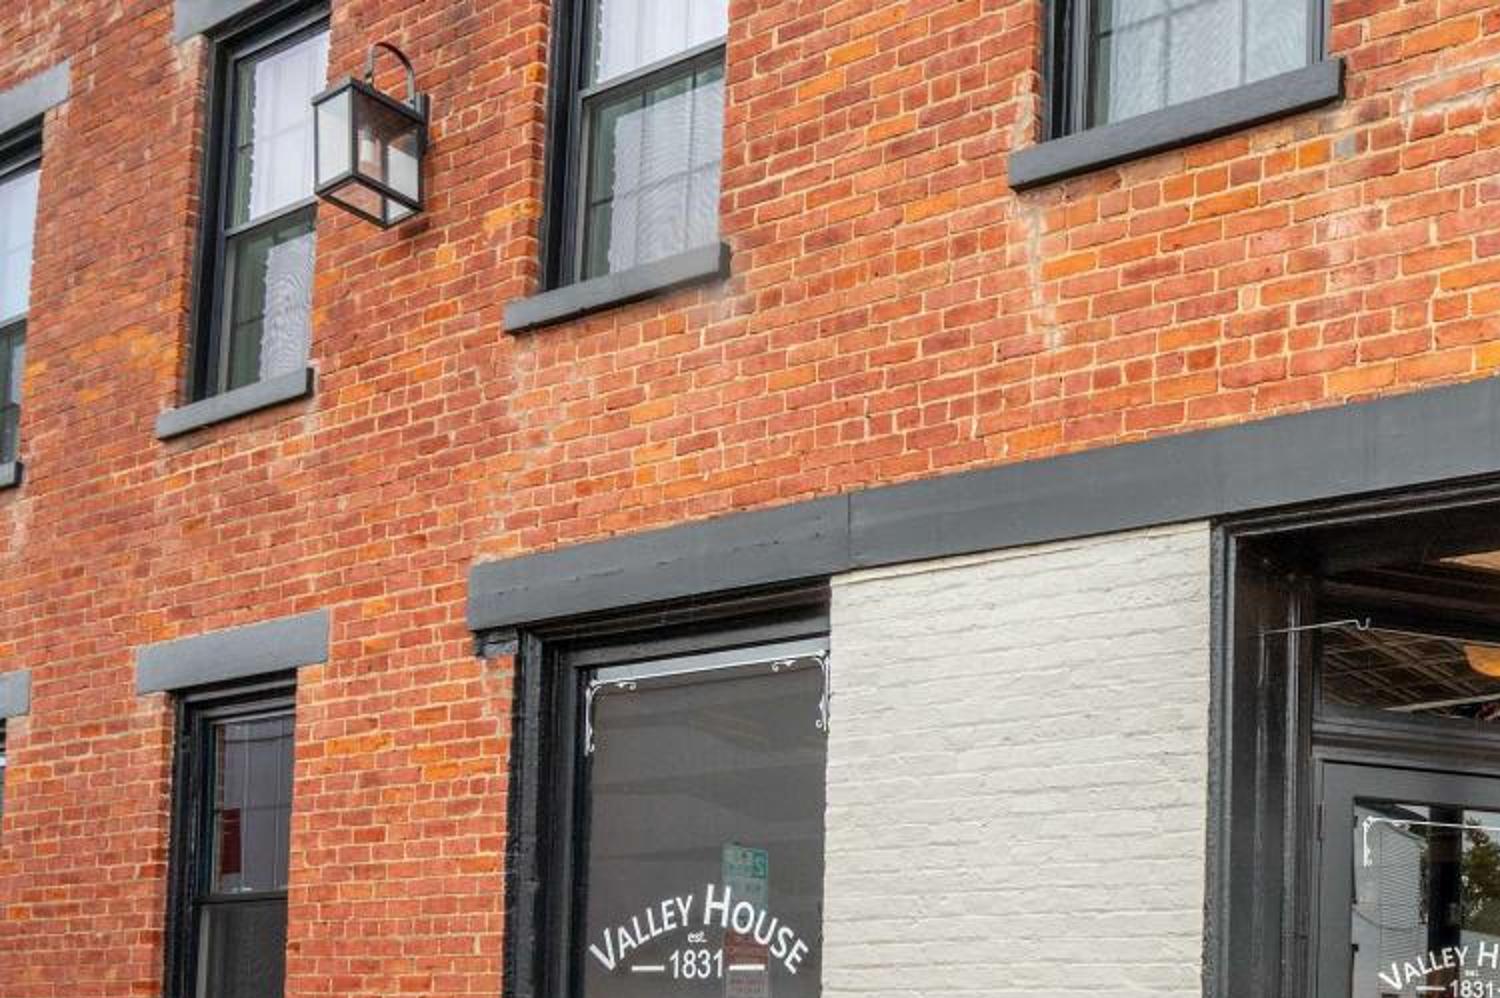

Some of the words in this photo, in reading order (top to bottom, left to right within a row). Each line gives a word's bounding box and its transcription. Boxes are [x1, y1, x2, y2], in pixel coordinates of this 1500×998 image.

[589, 894, 693, 972] VALLEY
[703, 883, 809, 975] HOUSE
[669, 949, 724, 979] 1831
[1378, 946, 1468, 991] VALLEY
[1450, 979, 1493, 998] 1831
